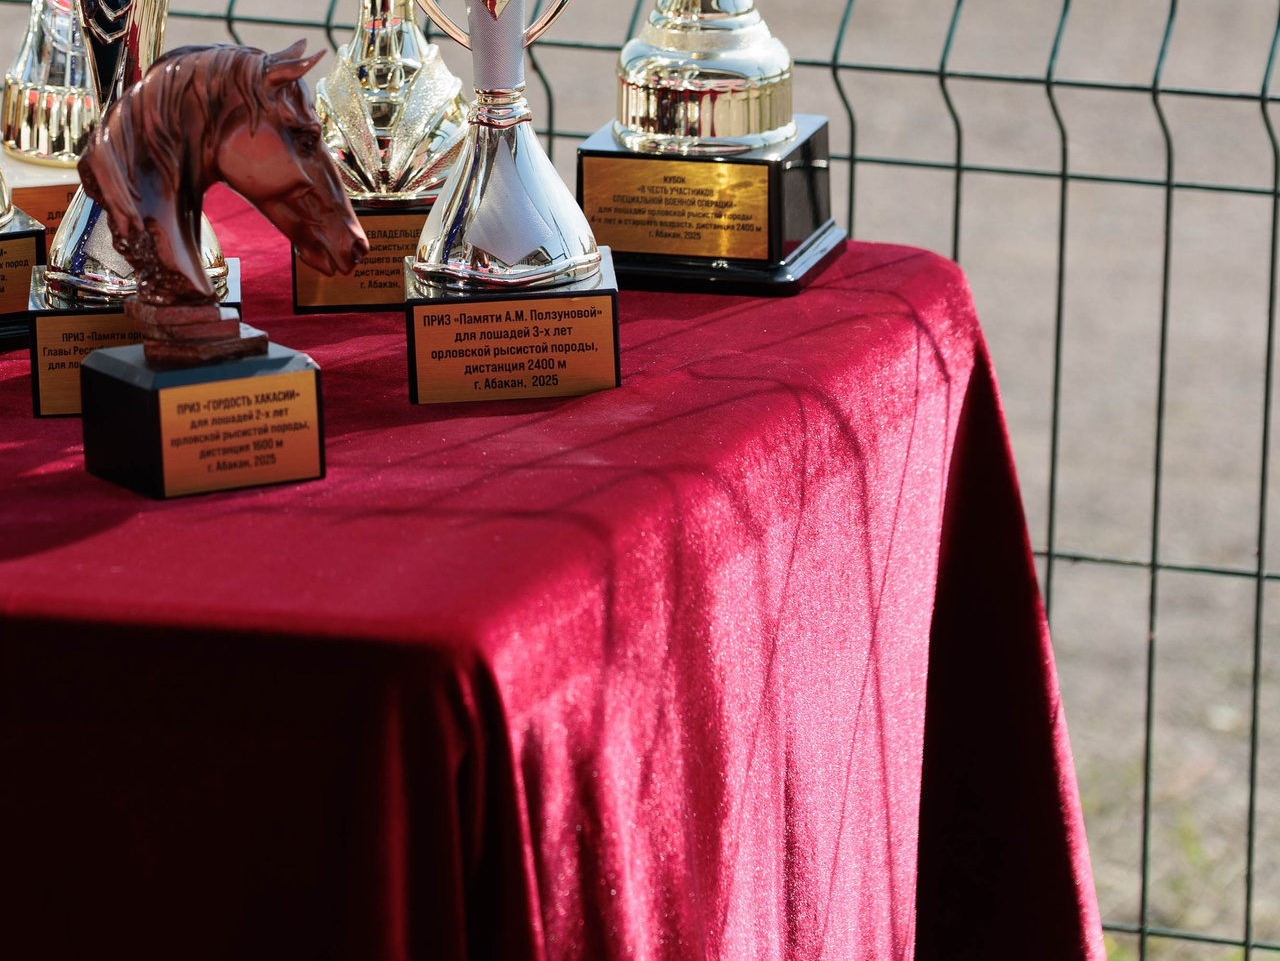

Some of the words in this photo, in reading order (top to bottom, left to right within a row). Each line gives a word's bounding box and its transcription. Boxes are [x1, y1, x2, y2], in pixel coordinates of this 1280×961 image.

[663, 175, 686, 184] КУБОК
[647, 186, 669, 195] ЧЕСТЬ
[670, 187, 714, 197] УЧАСТНИКОВ
[612, 194, 663, 204] СПЕЦИАЛЬНОЙ
[665, 197, 696, 207] ВОЕННОЙ
[598, 206, 612, 214] для
[648, 209, 686, 217] орловской
[737, 223, 754, 232] 2400
[365, 229, 423, 240] ЕВЛАДЕЛЬЦЕ
[684, 231, 701, 240] 2025
[369, 243, 409, 252] ысистых
[5, 259, 29, 270] пород
[354, 268, 400, 278] дистанция
[360, 281, 366, 289] г.
[423, 313, 451, 327] ПРИЗ
[454, 310, 502, 326] «Памяти
[505, 310, 528, 323] А.М.
[530, 306, 603, 323] Ползуновой»
[62, 332, 85, 343] ПРИЗ
[87, 331, 126, 342] «Памяти
[454, 332, 477, 343] для
[479, 326, 530, 341] лошадей
[533, 325, 551, 337] 3-х
[553, 326, 573, 336] лет
[43, 347, 72, 357] Главы
[431, 342, 491, 360] орловской
[493, 340, 548, 358] рысистой
[551, 341, 599, 356] породы,
[47, 361, 66, 371] для
[464, 361, 525, 375] дистанция
[528, 358, 555, 371] 2400
[558, 361, 567, 369] м
[474, 381, 482, 390] г.
[484, 376, 527, 390] Абакан,
[532, 374, 559, 387] 2025
[177, 402, 201, 415] ПРИЗ
[202, 395, 252, 411] «ГОРДОСТЬ
[254, 389, 300, 405] ХАКАСИИ»
[190, 419, 209, 430] для
[211, 412, 254, 427] лошадей
[255, 409, 270, 421] 2-х
[272, 407, 289, 418] лет
[171, 430, 220, 447] орловской
[222, 425, 269, 442] рысистой
[199, 443, 250, 460] дистанция
[252, 439, 274, 451] 1600
[275, 439, 283, 448] м
[207, 465, 213, 473] г.
[254, 453, 277, 466] 2025
